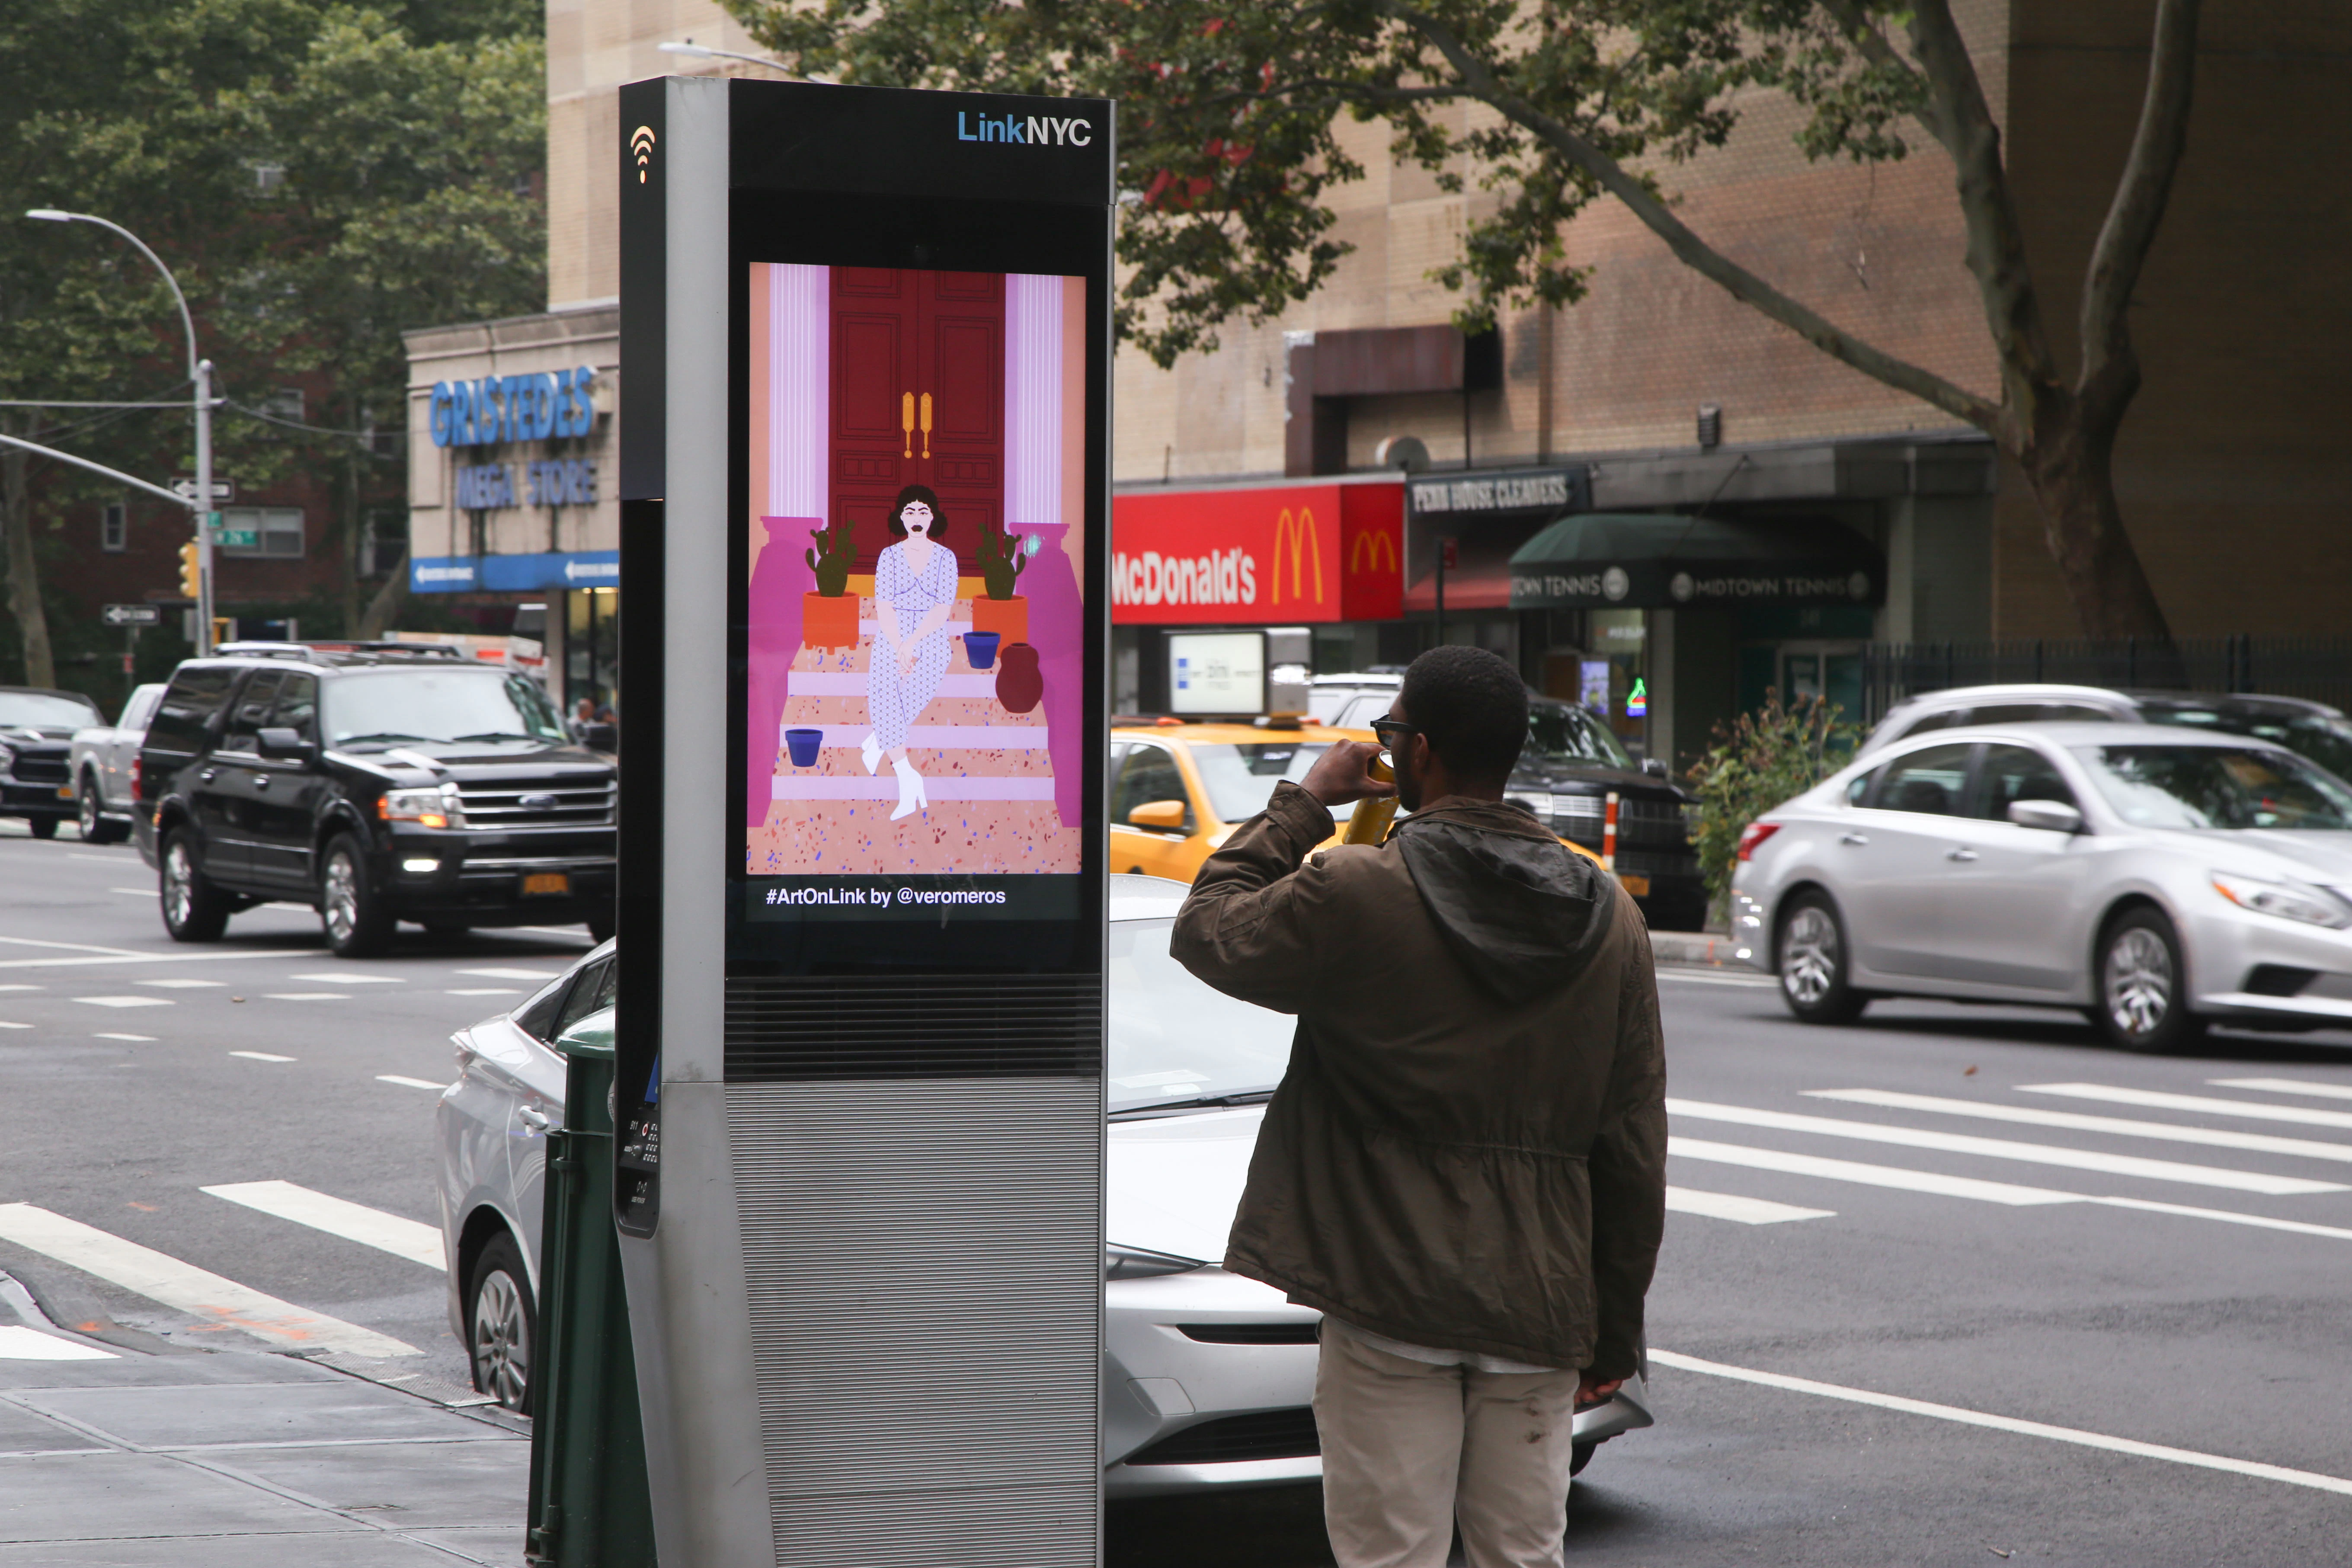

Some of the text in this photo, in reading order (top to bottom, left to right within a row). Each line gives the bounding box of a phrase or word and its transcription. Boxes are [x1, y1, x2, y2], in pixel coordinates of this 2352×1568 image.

[959, 111, 1091, 146] LinkNYC
[430, 366, 594, 447] GRISTEDES
[458, 459, 595, 508] MEGA STORE
[1451, 480, 1495, 510] HOUSE
[1112, 547, 1256, 605] McDonald's
[1544, 575, 1600, 596] TENNIS
[1696, 577, 1779, 597] MIDTOWN
[1786, 576, 1846, 596] TENNIS
[766, 887, 1006, 908] #ArtOnLink by @veromeros
[630, 1120, 639, 1130] 911
